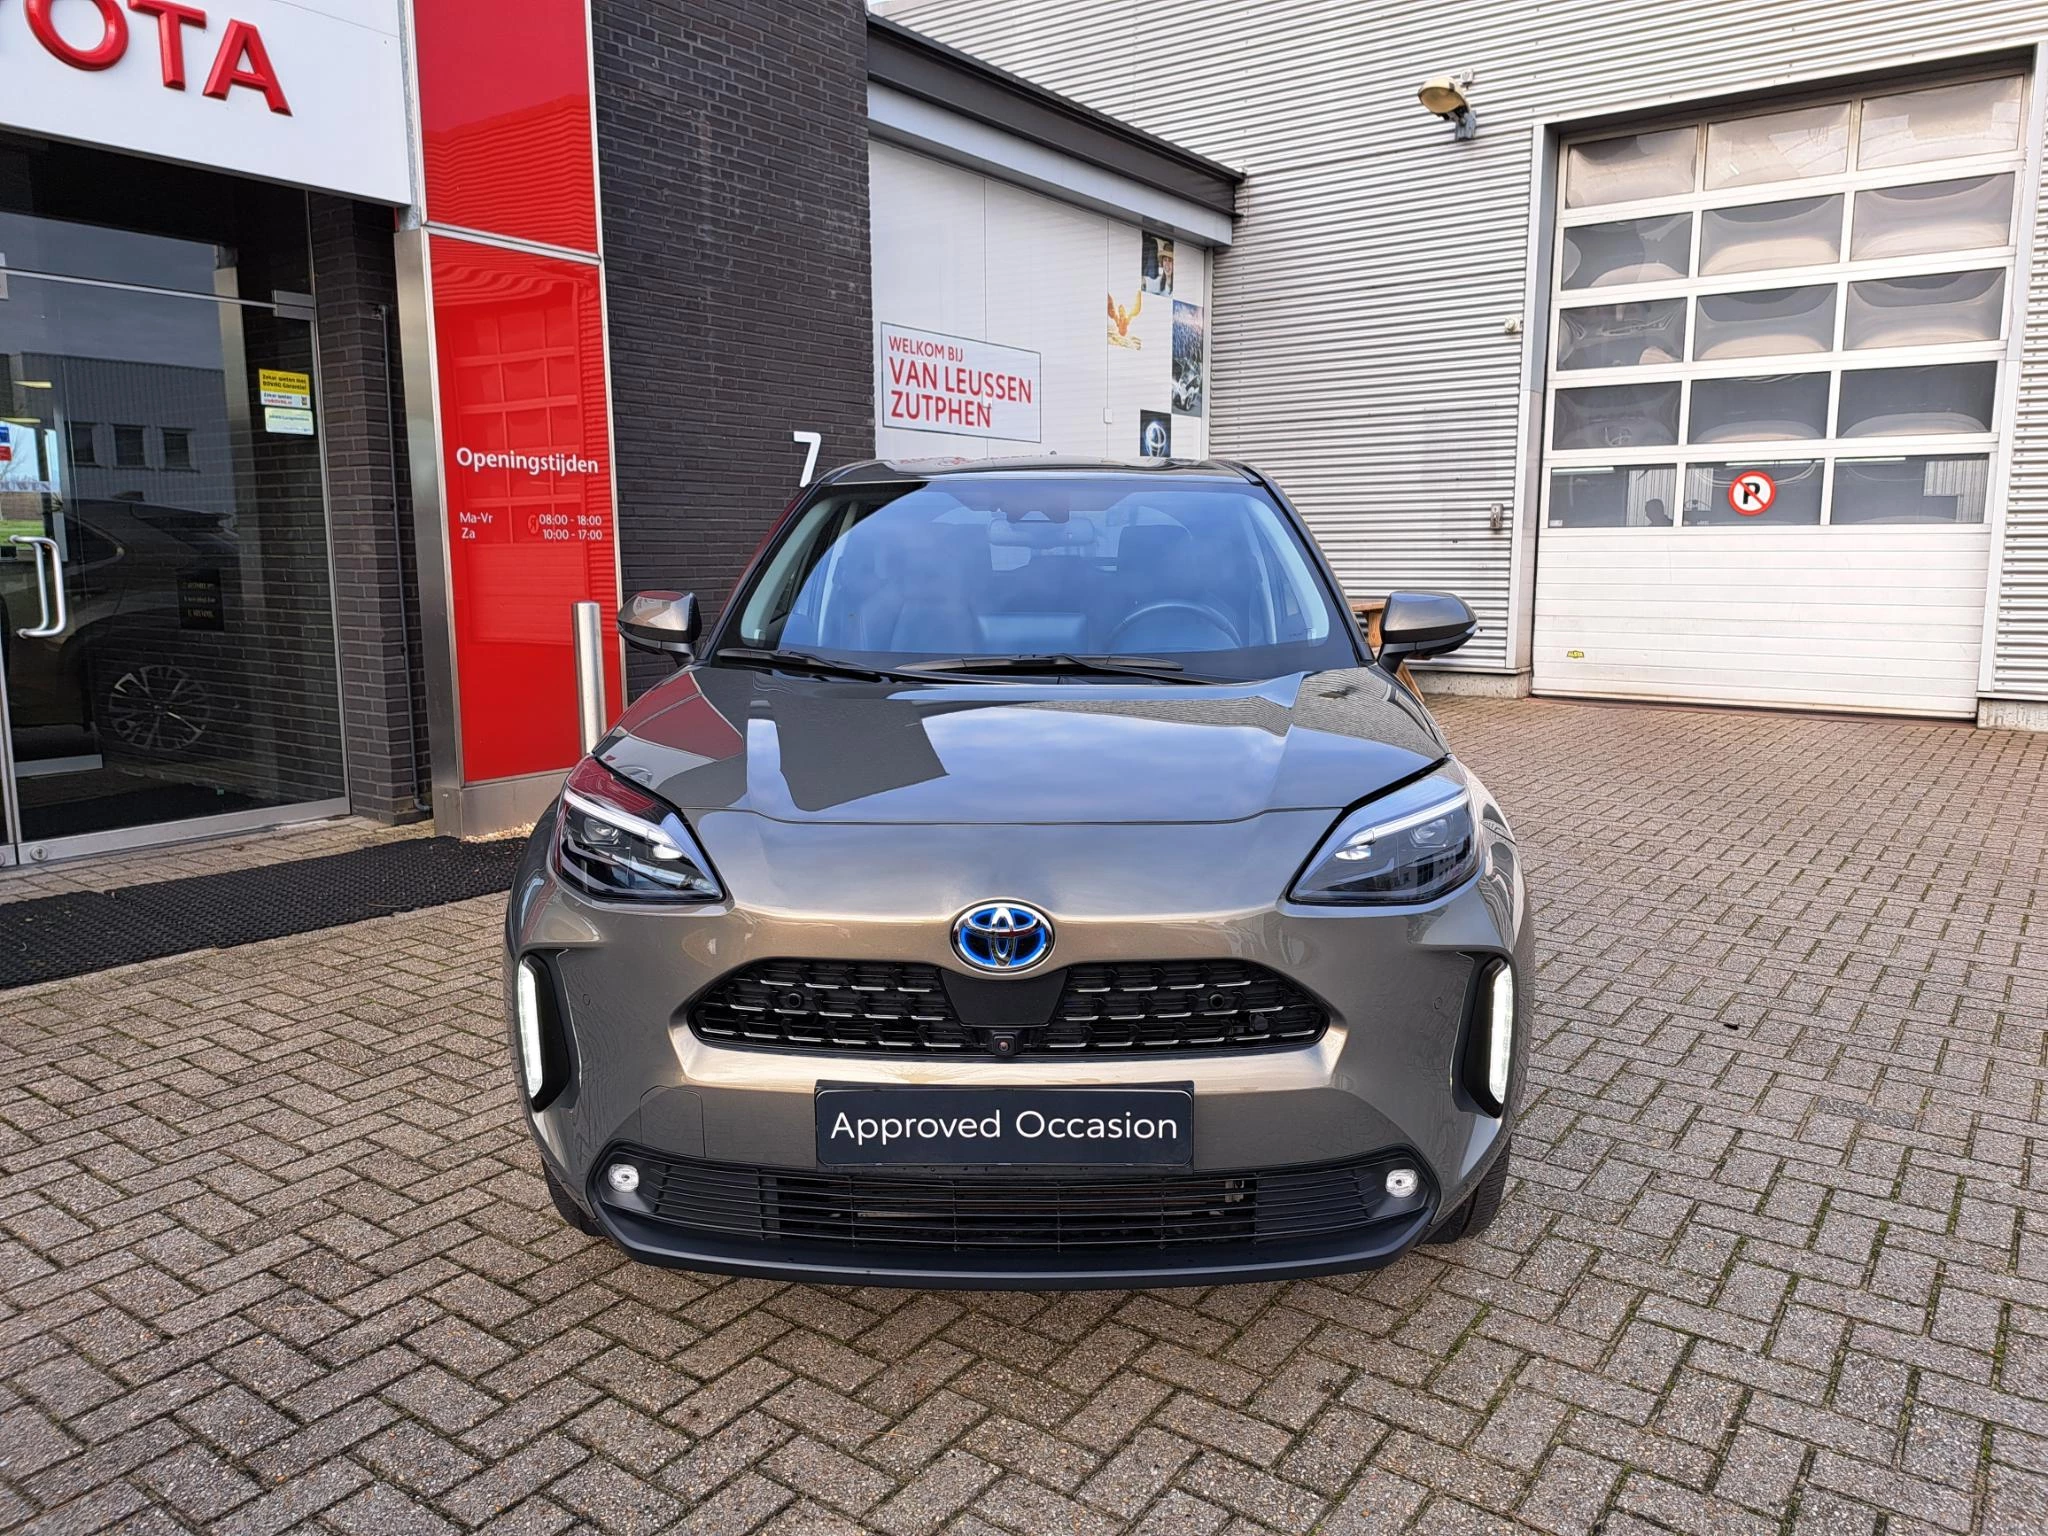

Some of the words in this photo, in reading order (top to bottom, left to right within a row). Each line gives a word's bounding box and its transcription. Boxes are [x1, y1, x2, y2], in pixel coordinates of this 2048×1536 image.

[24, 0, 292, 117] OTA
[889, 335, 944, 359] WELKOM
[948, 346, 964, 362] BIJ
[889, 356, 937, 390] VAN
[945, 366, 1031, 404] LEUSSEN
[891, 389, 991, 428] ZUTPHEN
[456, 447, 599, 476] Openingstijden
[793, 431, 821, 488] 7
[459, 512, 493, 524] Ma-Vr
[539, 514, 568, 526] 08:00
[577, 515, 602, 526] 18:00
[461, 528, 476, 539] Za
[543, 529, 569, 540] 10:00
[578, 529, 602, 540] 17:00
[830, 1109, 1001, 1146] Approved
[1015, 1110, 1178, 1140] Occasion
